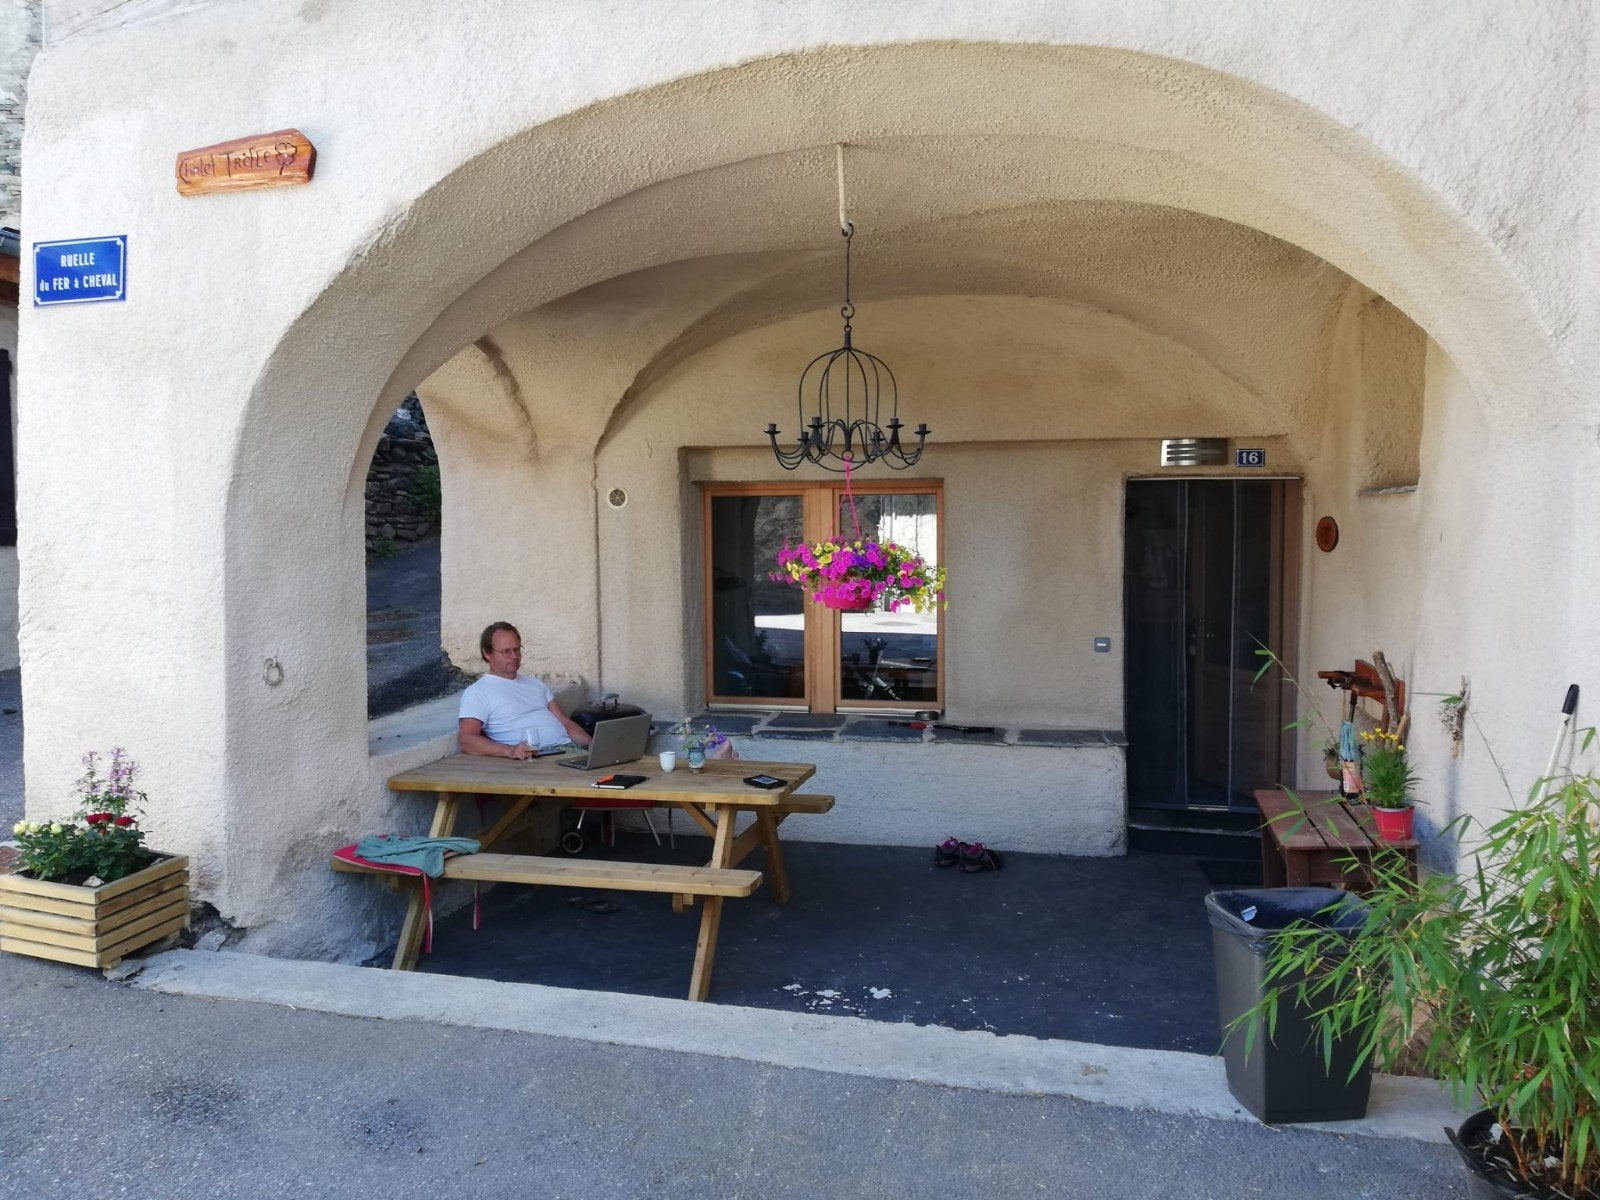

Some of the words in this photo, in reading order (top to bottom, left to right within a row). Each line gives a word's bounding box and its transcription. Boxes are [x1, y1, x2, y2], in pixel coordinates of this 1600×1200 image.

[179, 153, 216, 183] Chalet
[60, 252, 95, 268] RUELLE
[39, 279, 50, 292] du
[53, 277, 70, 291] FER
[83, 273, 118, 288] CHEVAL
[1241, 452, 1259, 464] 16
